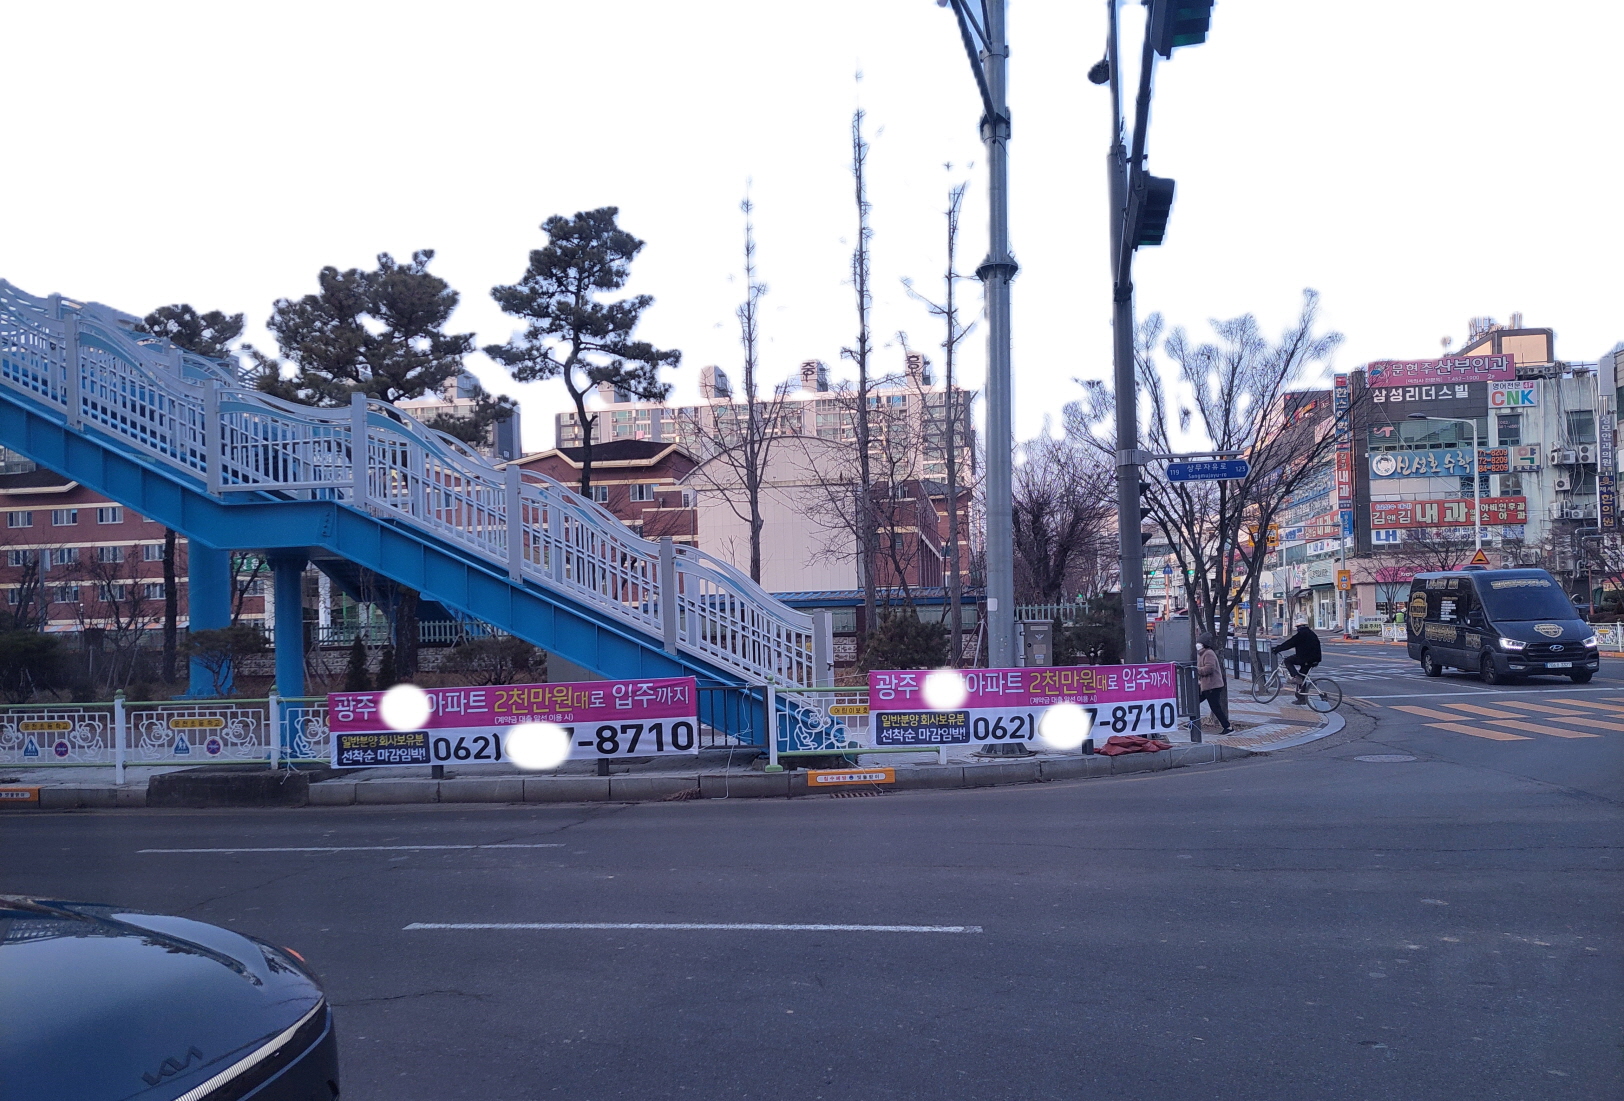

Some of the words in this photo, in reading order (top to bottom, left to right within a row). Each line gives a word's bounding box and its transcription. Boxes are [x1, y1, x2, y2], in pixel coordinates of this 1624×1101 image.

[1372, 384, 1469, 403] 삼성리더스빌
[1492, 382, 1521, 390] 영어전문
[1491, 390, 1534, 406] CNK
[1187, 462, 1227, 472] 상무자유로
[1396, 452, 1441, 476] 신성호
[1443, 450, 1473, 474] 수학
[1338, 470, 1350, 497] 내과
[1373, 511, 1412, 524] 김앤김
[1415, 502, 1468, 524] 내과
[1601, 493, 1614, 528] 한의원
[875, 674, 919, 700] 광주
[1029, 669, 1119, 695] 2천만원대로
[1122, 667, 1171, 692] 입주까지
[334, 695, 376, 721] 광주
[494, 686, 606, 713] 2천만원대로
[612, 682, 689, 709] 입주까지
[881, 714, 919, 727] 일반분양
[920, 713, 965, 726] 회사보유분
[341, 735, 378, 749] 일반분양
[379, 733, 425, 747] 회사보유분
[881, 728, 916, 743] 선착순
[918, 727, 966, 743] 마감임박!
[341, 749, 376, 763] 선착순
[377, 747, 426, 762] 마감임박!
